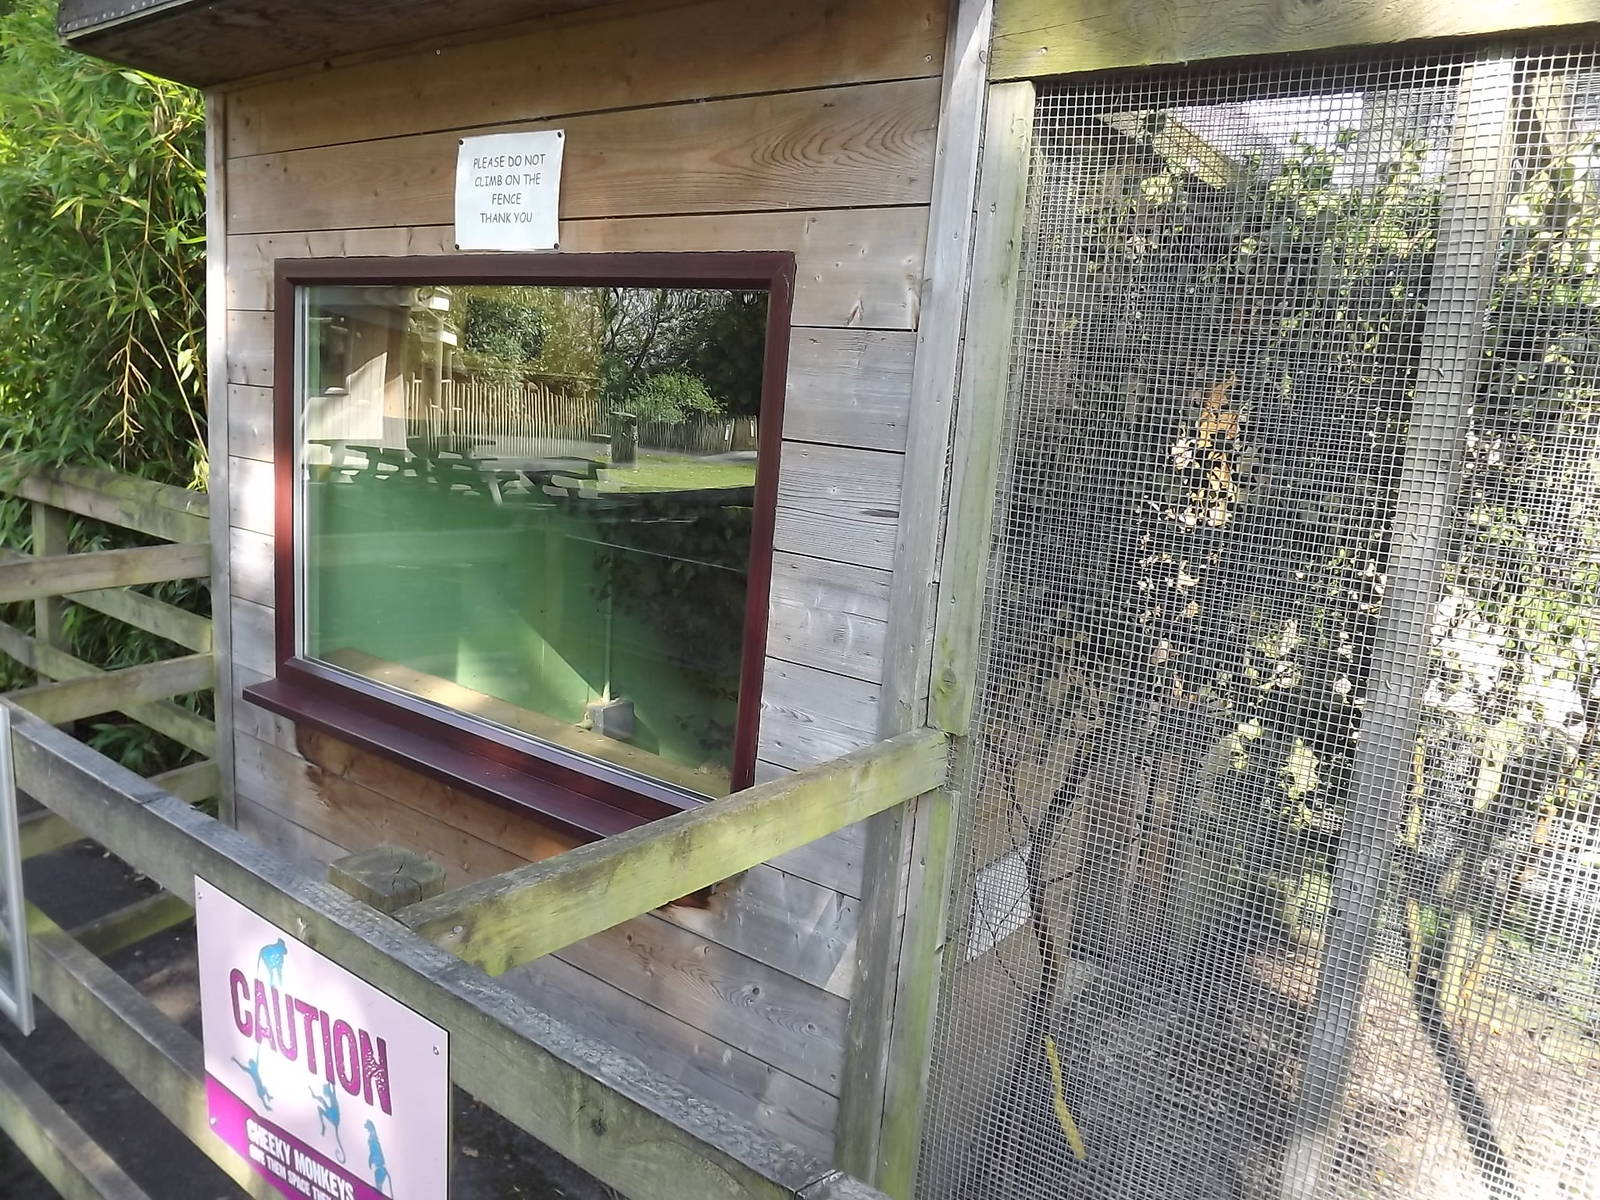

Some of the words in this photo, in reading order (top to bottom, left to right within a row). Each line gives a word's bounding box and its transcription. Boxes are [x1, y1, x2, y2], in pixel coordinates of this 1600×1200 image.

[473, 155, 505, 169] PLEASE
[508, 155, 522, 168] DO
[525, 154, 546, 166] NOT
[474, 175, 503, 187] CLIMB
[505, 174, 520, 185] ON
[524, 173, 541, 185] THE
[492, 193, 522, 205] FENCE
[480, 213, 512, 224] THANK
[514, 212, 533, 223] YOU
[229, 967, 393, 1117] CAUTION
[293, 1148, 355, 1200] MONKEYS
